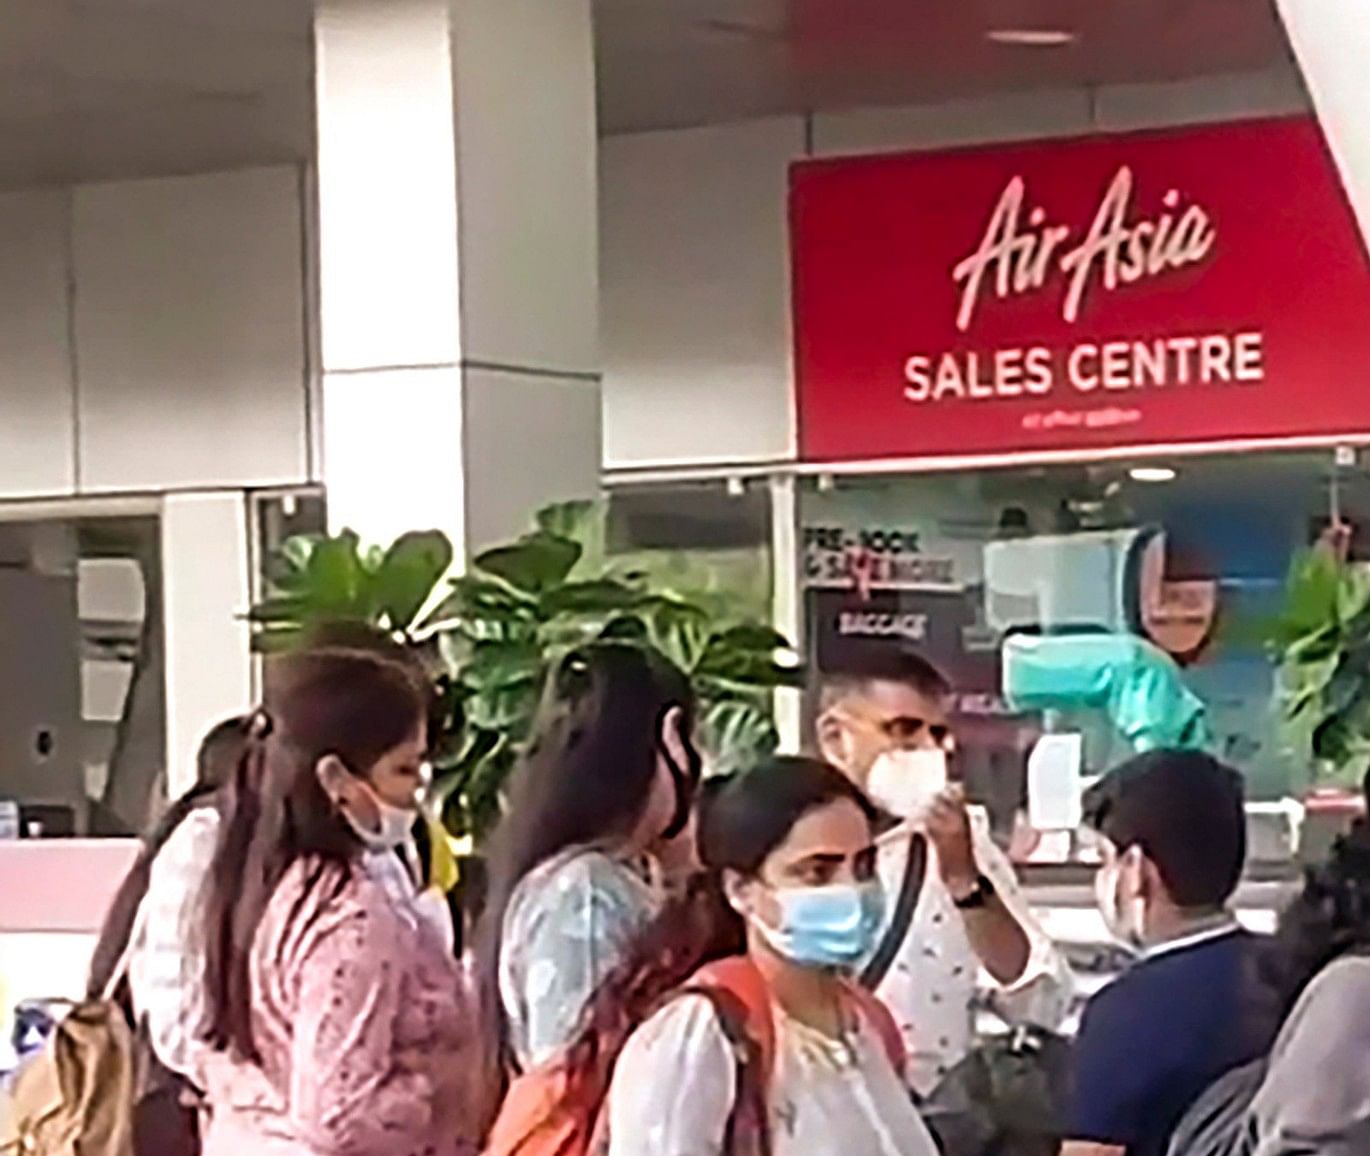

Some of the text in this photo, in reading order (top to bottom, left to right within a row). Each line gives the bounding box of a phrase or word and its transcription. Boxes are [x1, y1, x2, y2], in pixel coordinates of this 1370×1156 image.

[904, 332, 1265, 401] SALES CENTRE
[839, 612, 928, 640] BAGGAGE
